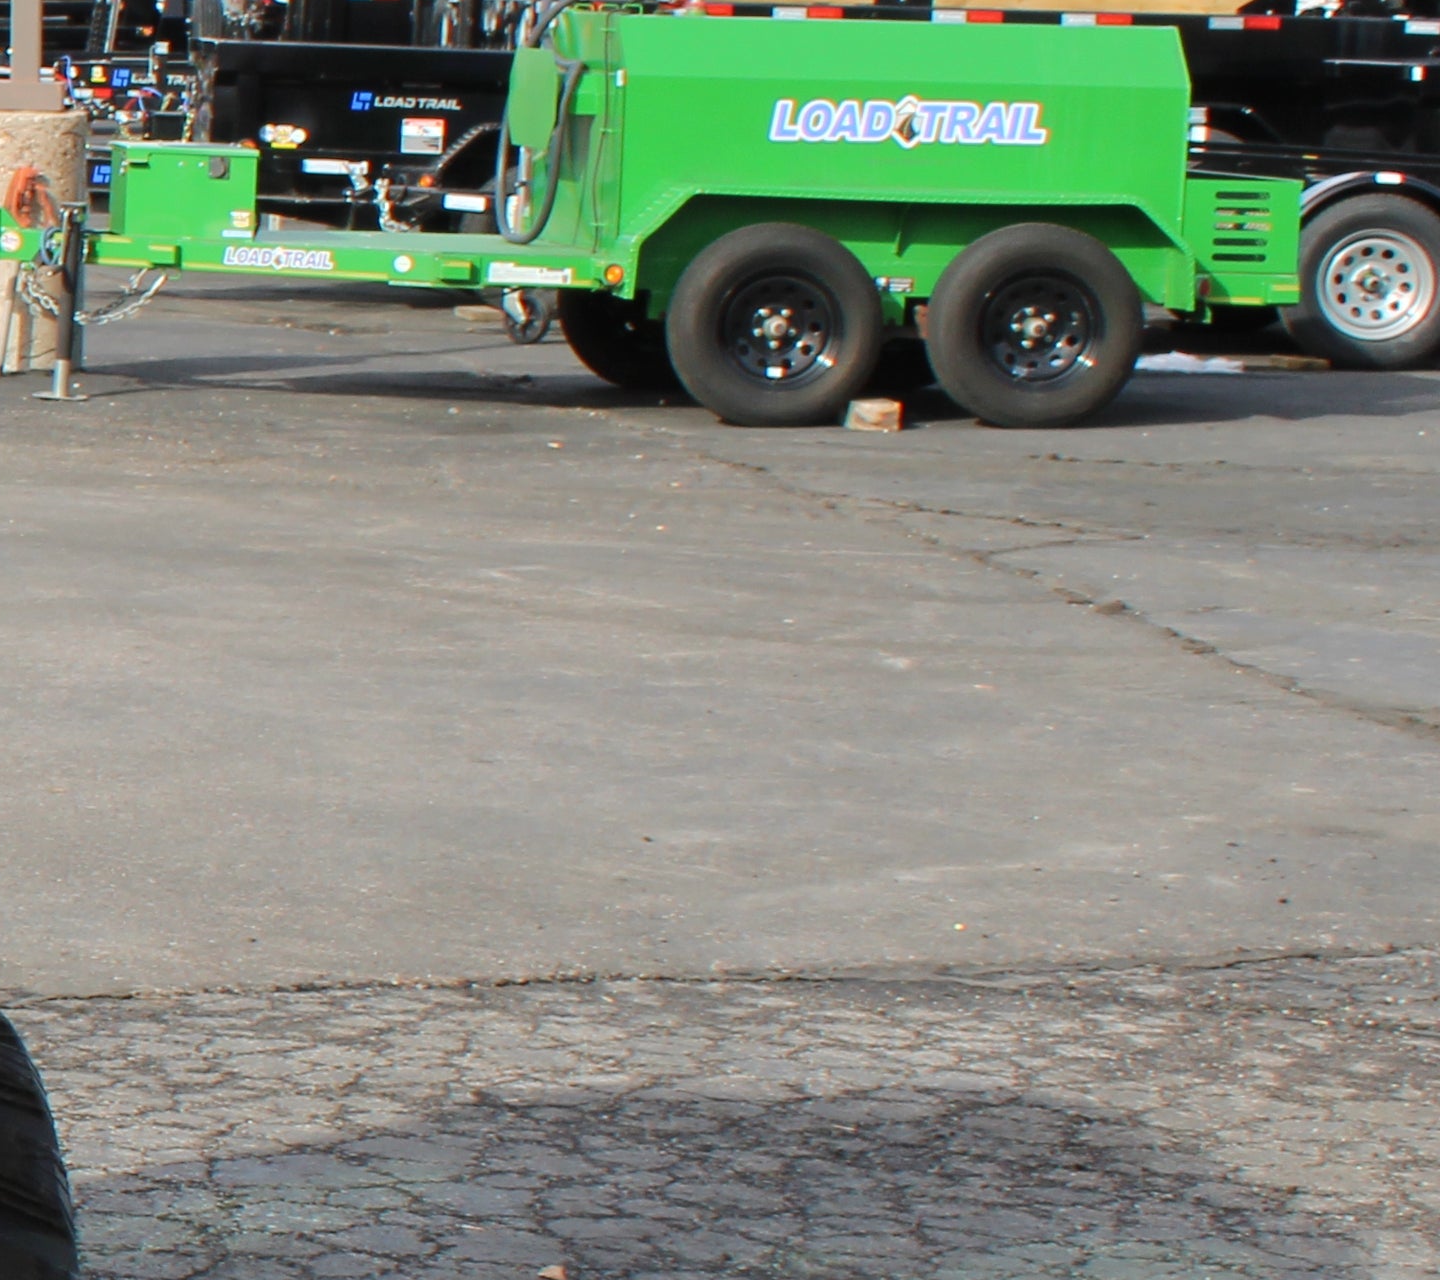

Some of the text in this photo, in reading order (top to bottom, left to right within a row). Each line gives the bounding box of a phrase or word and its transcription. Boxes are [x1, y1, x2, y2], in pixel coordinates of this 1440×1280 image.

[374, 96, 417, 109] LOAD
[417, 96, 462, 111] TRAIL
[771, 100, 1046, 143] LOAD TRAIL
[225, 247, 333, 269] LOAD TRAIL
